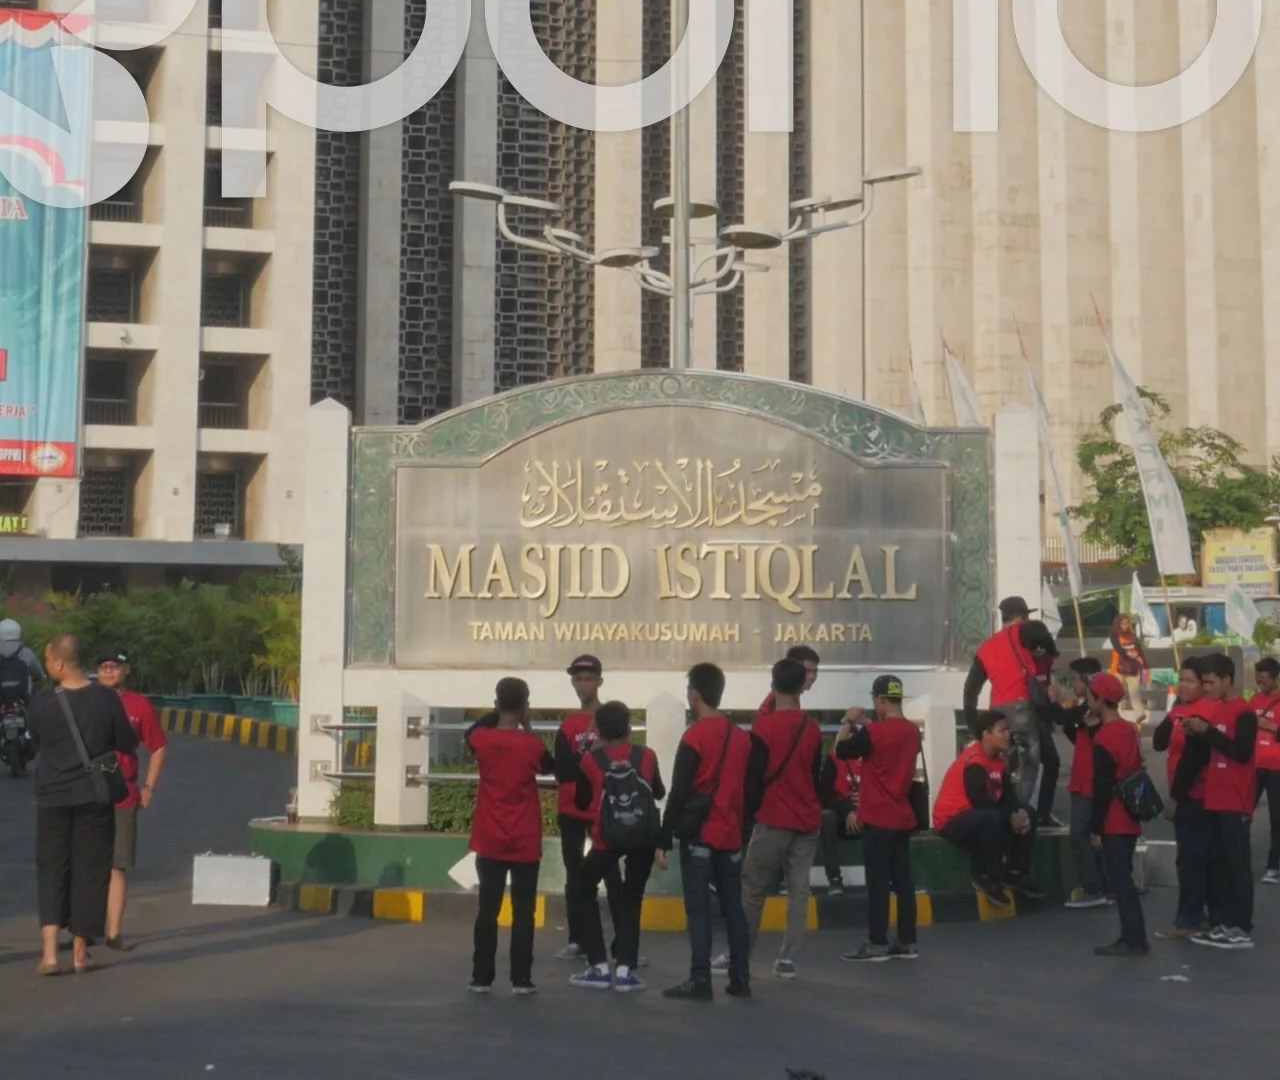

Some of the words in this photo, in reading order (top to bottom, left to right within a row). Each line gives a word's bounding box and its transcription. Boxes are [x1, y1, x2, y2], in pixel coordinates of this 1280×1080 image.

[424, 543, 631, 619] MASJID
[653, 539, 917, 613] ISTIQLAL
[469, 621, 545, 642] TAMAN
[554, 622, 740, 643] WIJAYAKUSUMAH
[774, 623, 873, 643] JAKARTA
